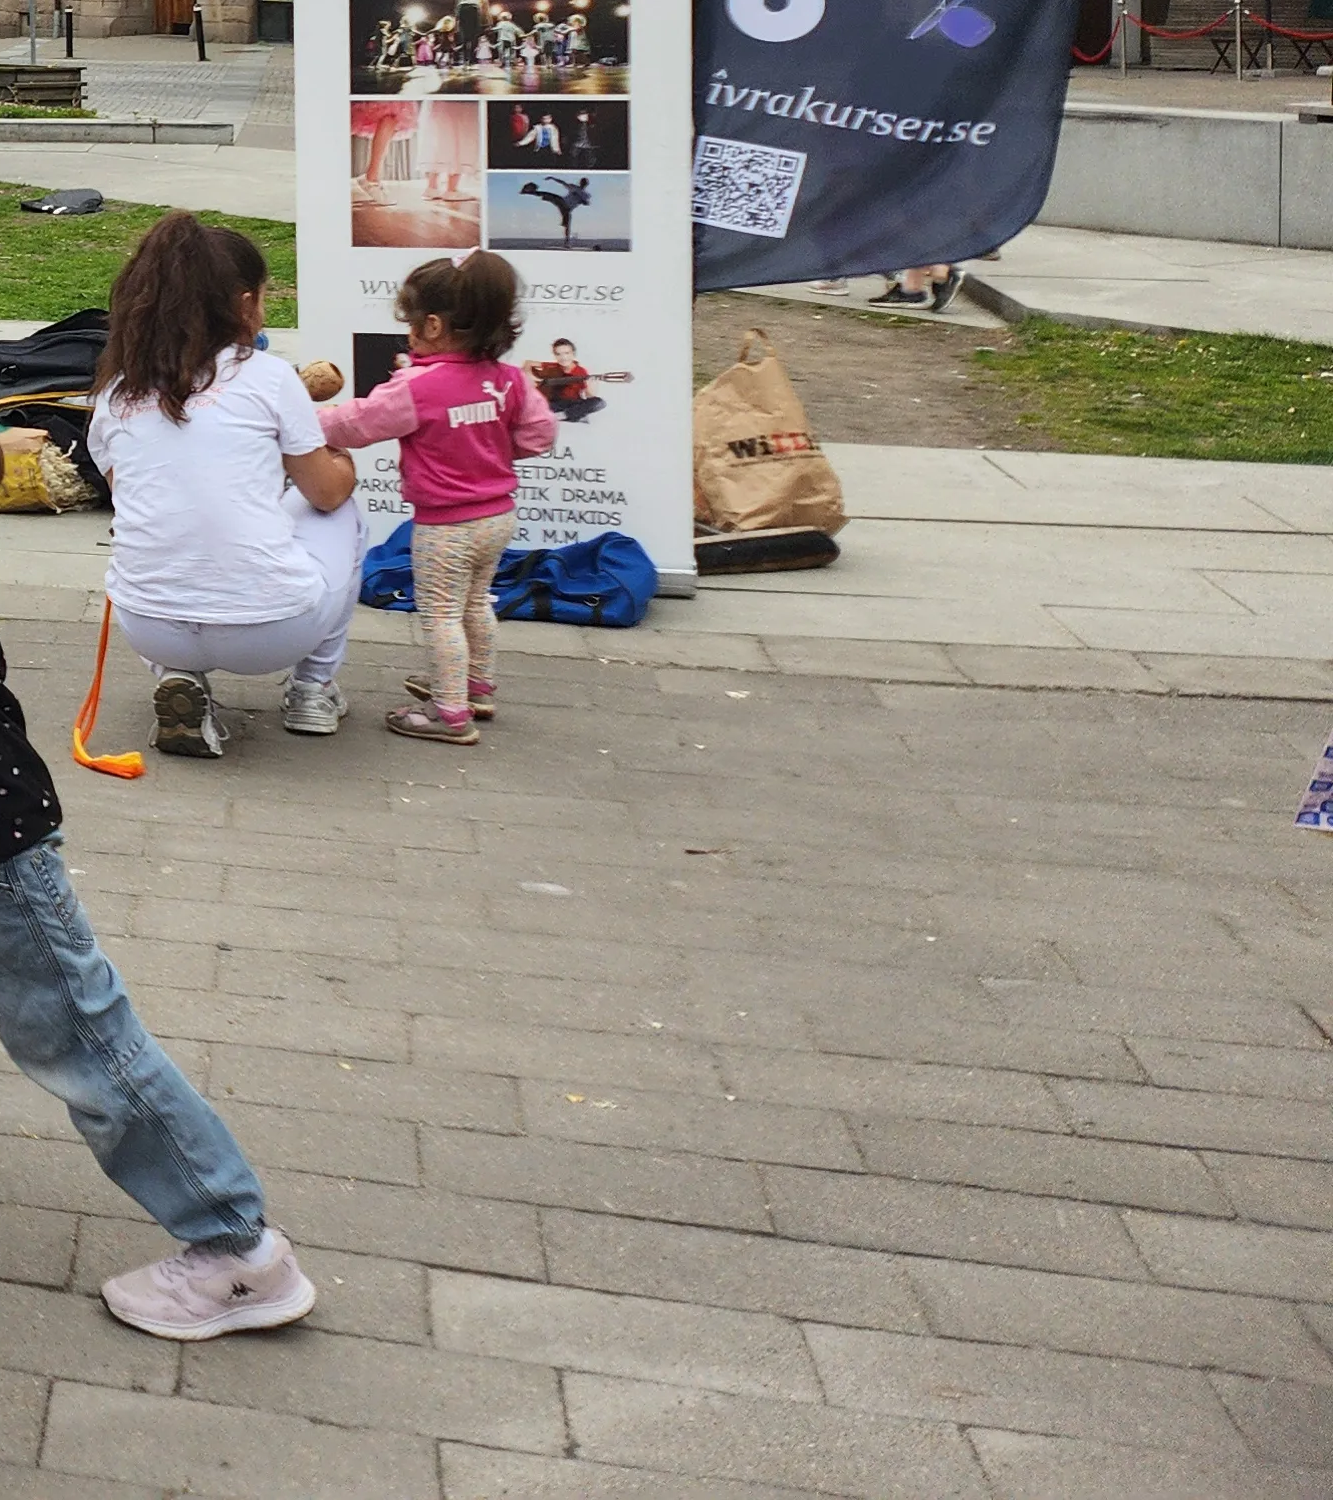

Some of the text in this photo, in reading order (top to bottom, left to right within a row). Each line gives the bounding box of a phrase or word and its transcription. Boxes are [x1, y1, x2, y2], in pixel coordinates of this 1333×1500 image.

[706, 70, 996, 146] ivrakurser.se
[562, 488, 628, 505] DRAMA
[517, 507, 621, 526] CONTAKIDS
